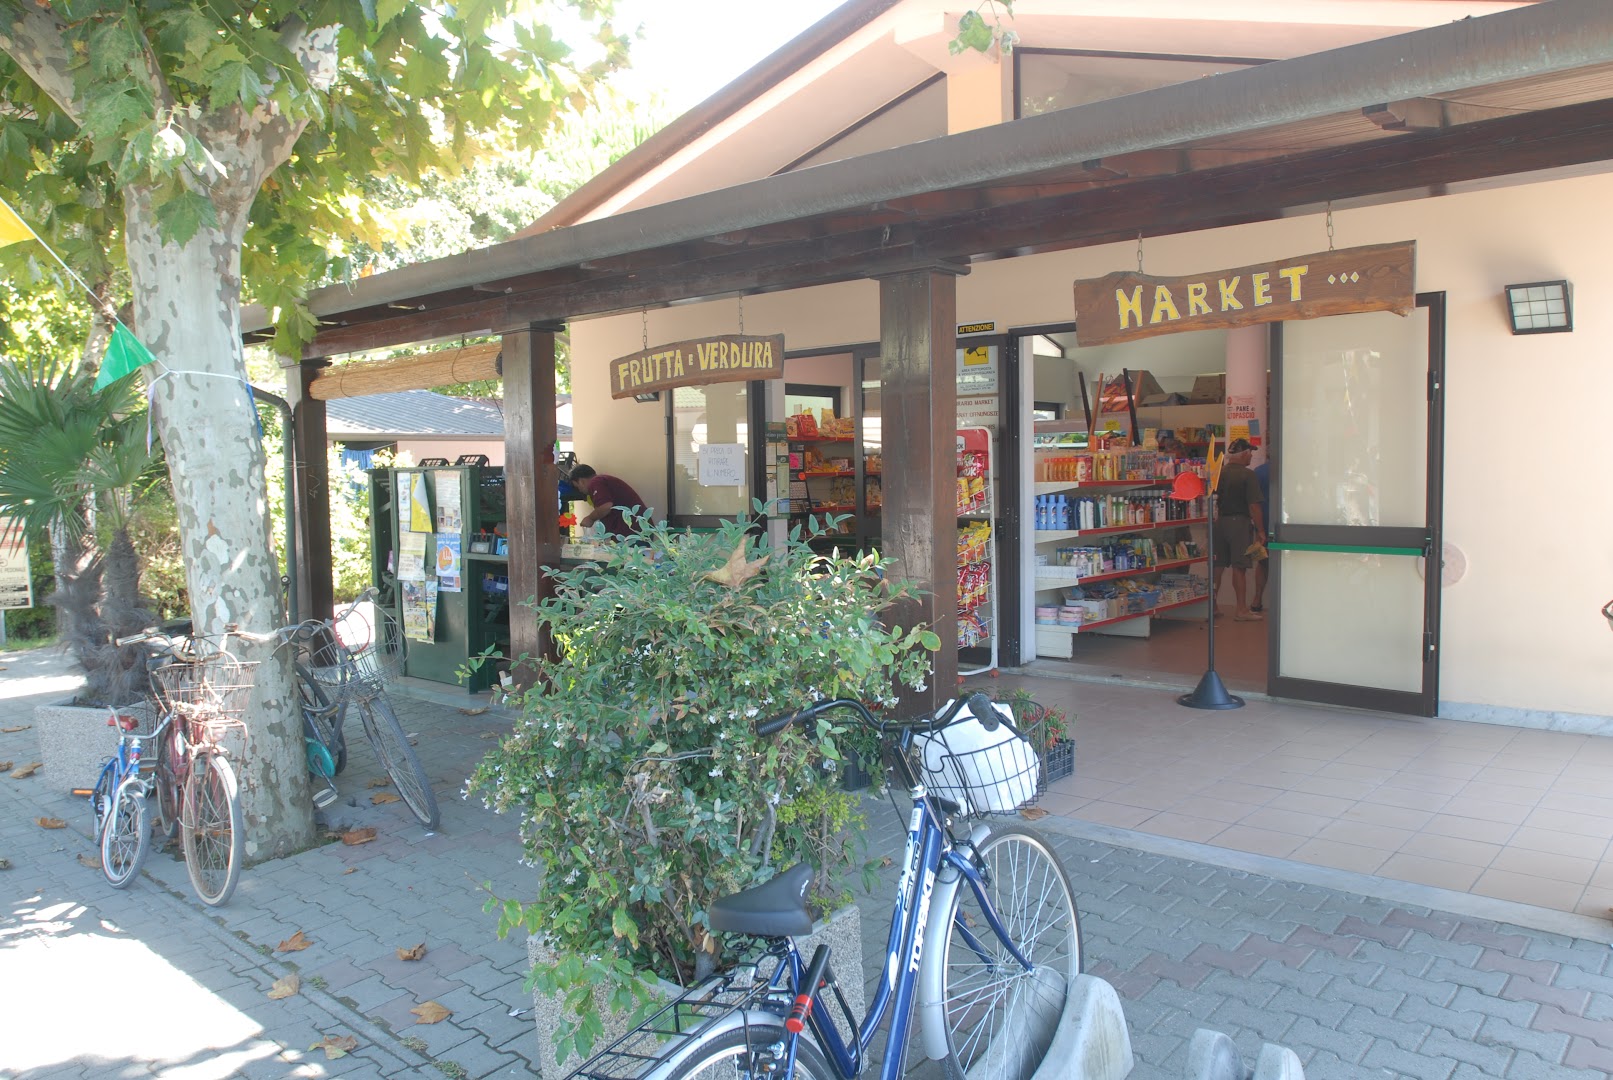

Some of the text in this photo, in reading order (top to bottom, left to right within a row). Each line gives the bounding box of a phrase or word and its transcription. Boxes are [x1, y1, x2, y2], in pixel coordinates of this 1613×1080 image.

[1116, 265, 1308, 329] MARKET
[618, 341, 773, 390] FRUTTA E VERDURA
[909, 867, 936, 973] TOPBIKE
